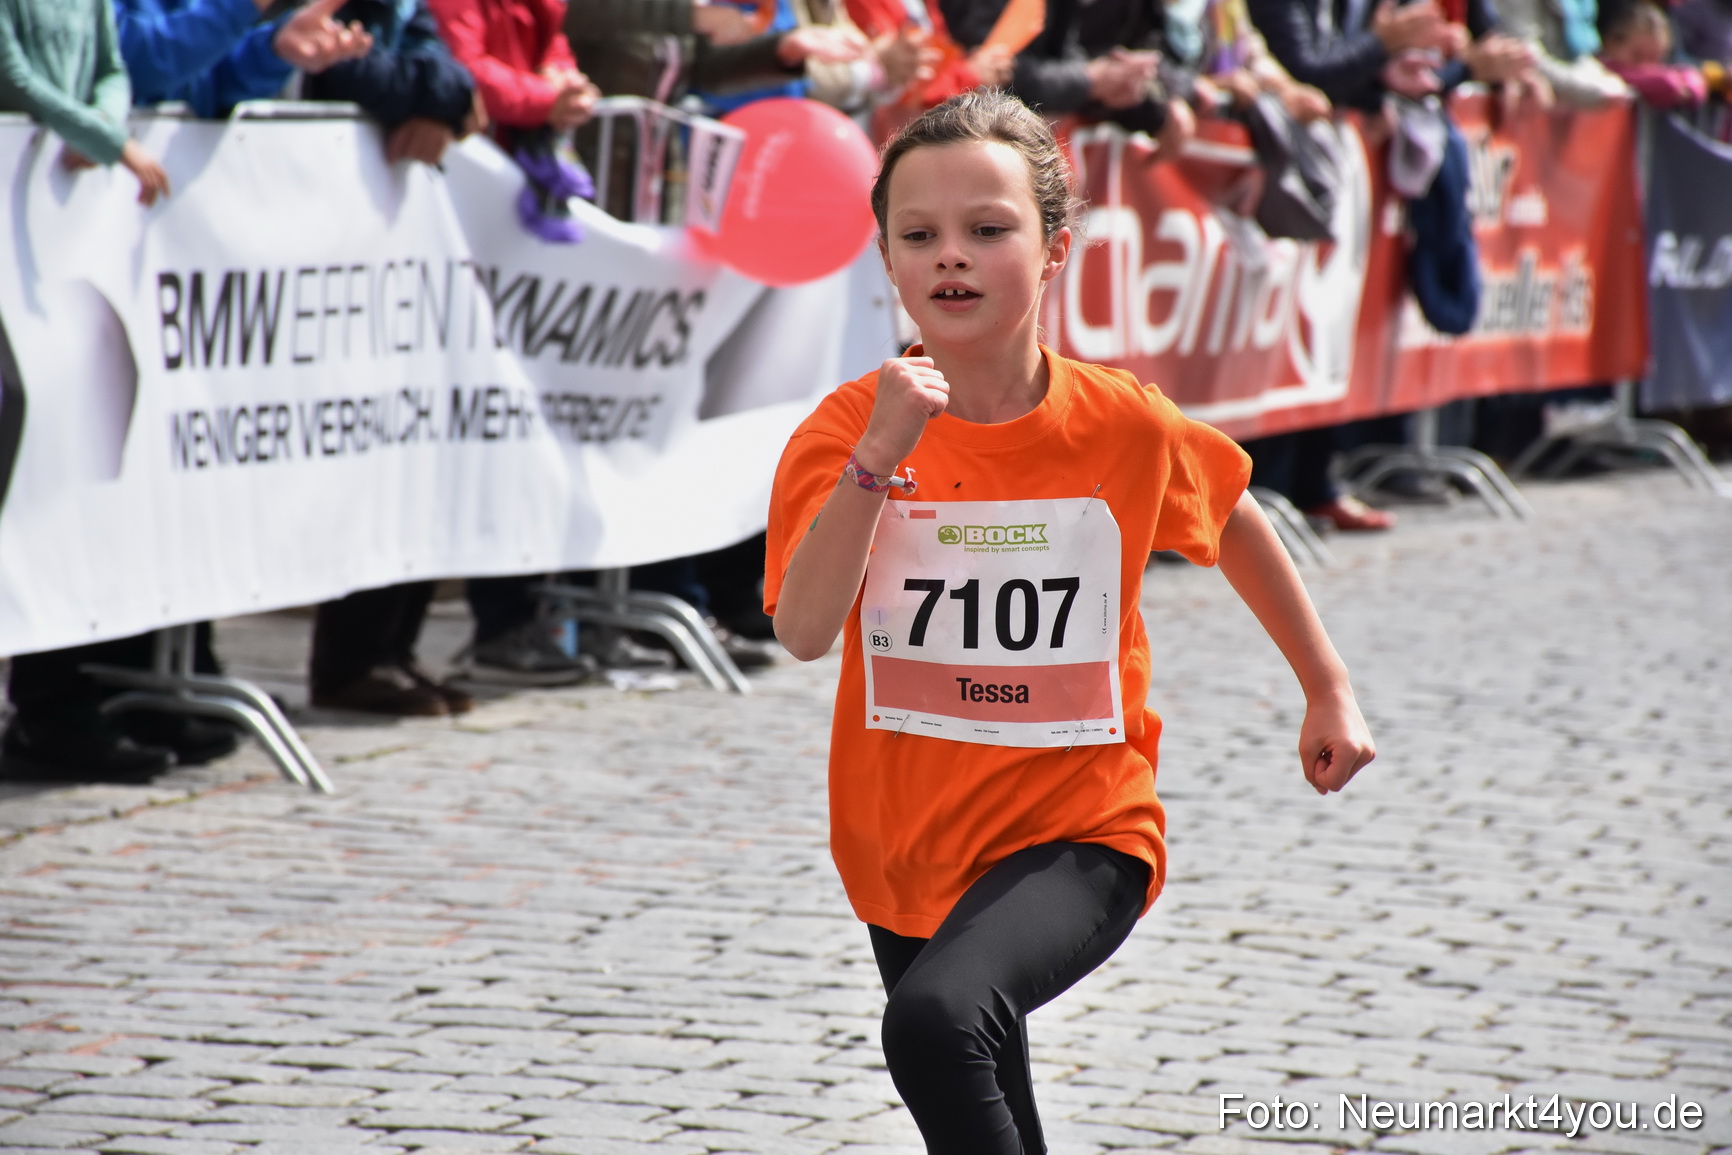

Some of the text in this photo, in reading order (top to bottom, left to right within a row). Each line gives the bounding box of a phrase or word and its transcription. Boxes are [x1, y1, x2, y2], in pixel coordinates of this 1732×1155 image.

[157, 270, 286, 371] BMW
[964, 524, 1048, 545] BOCK
[1021, 545, 1050, 553] concepts
[904, 577, 1080, 651] 7107
[872, 634, 889, 648] B3
[956, 677, 1029, 704] Tessa
